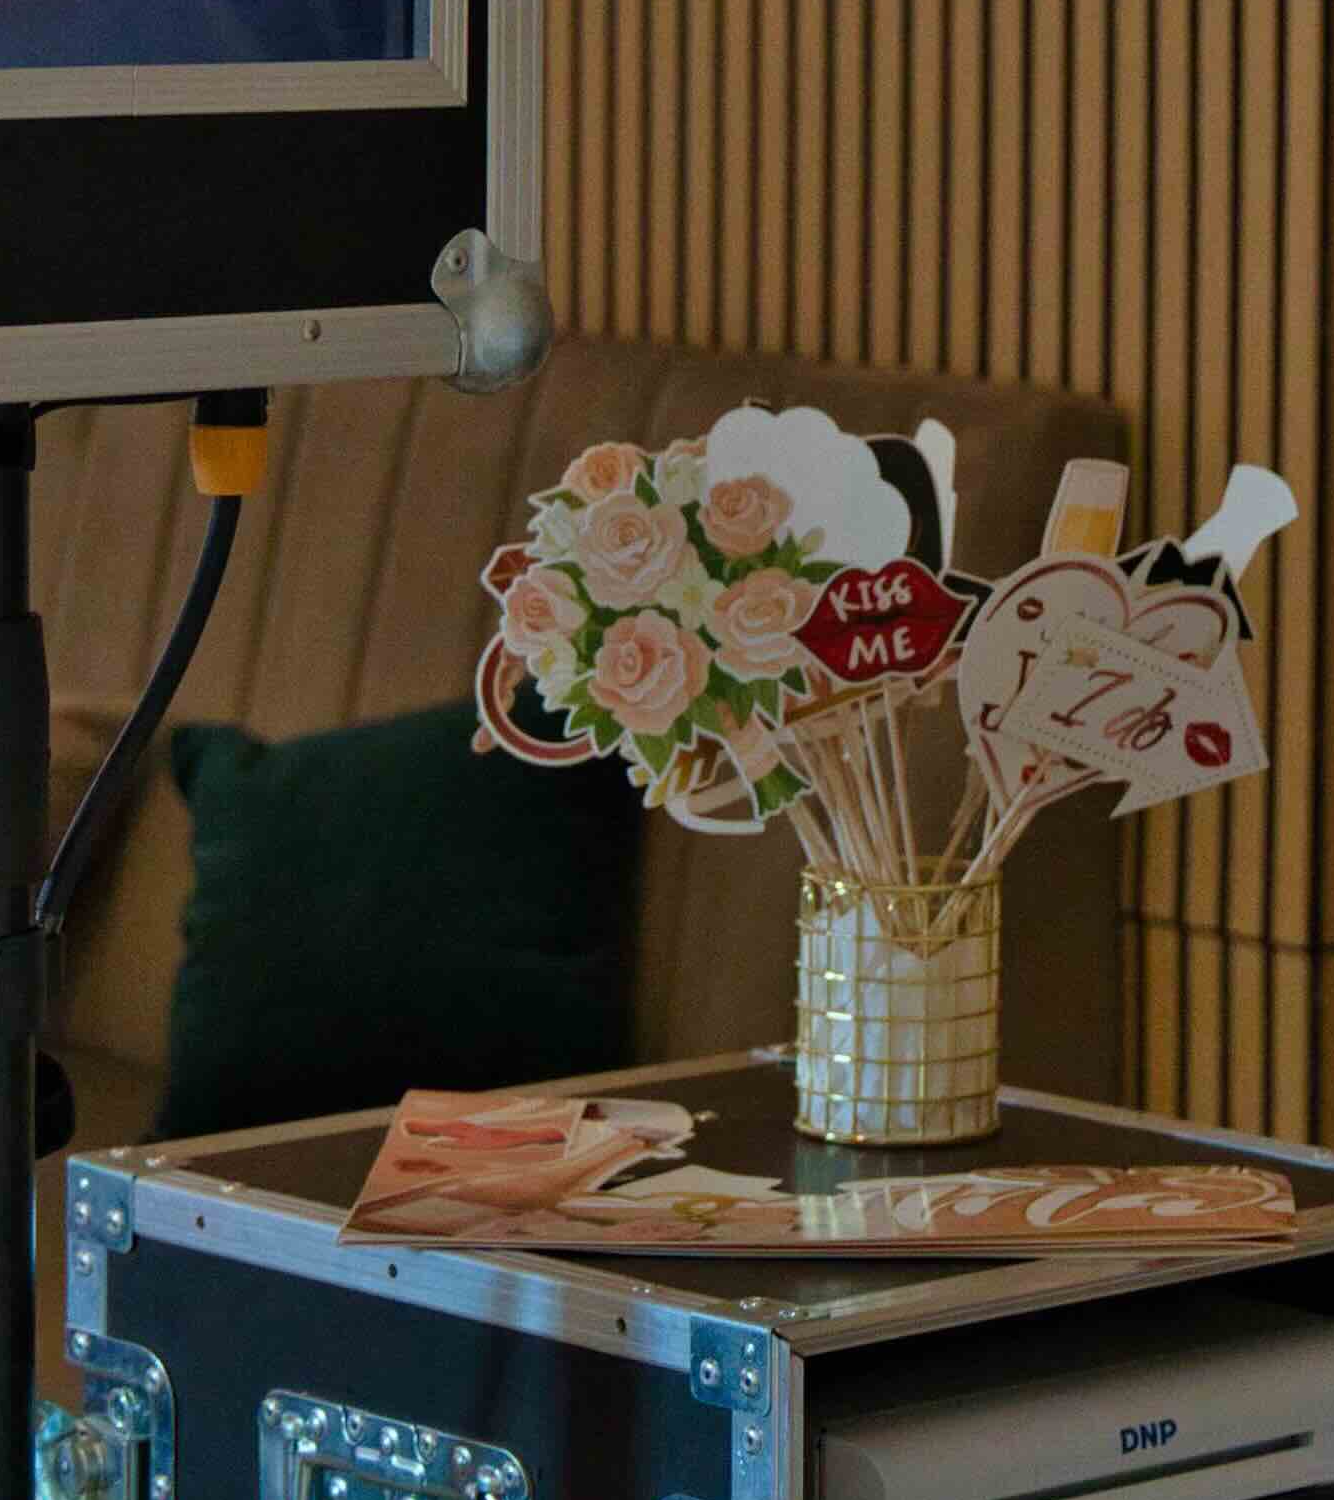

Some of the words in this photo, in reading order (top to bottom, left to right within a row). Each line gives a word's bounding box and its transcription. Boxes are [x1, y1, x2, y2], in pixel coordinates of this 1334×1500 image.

[829, 571, 915, 624] KISS
[848, 625, 916, 671] ME
[1102, 687, 1178, 753] do
[1119, 1418, 1177, 1456] DNP
